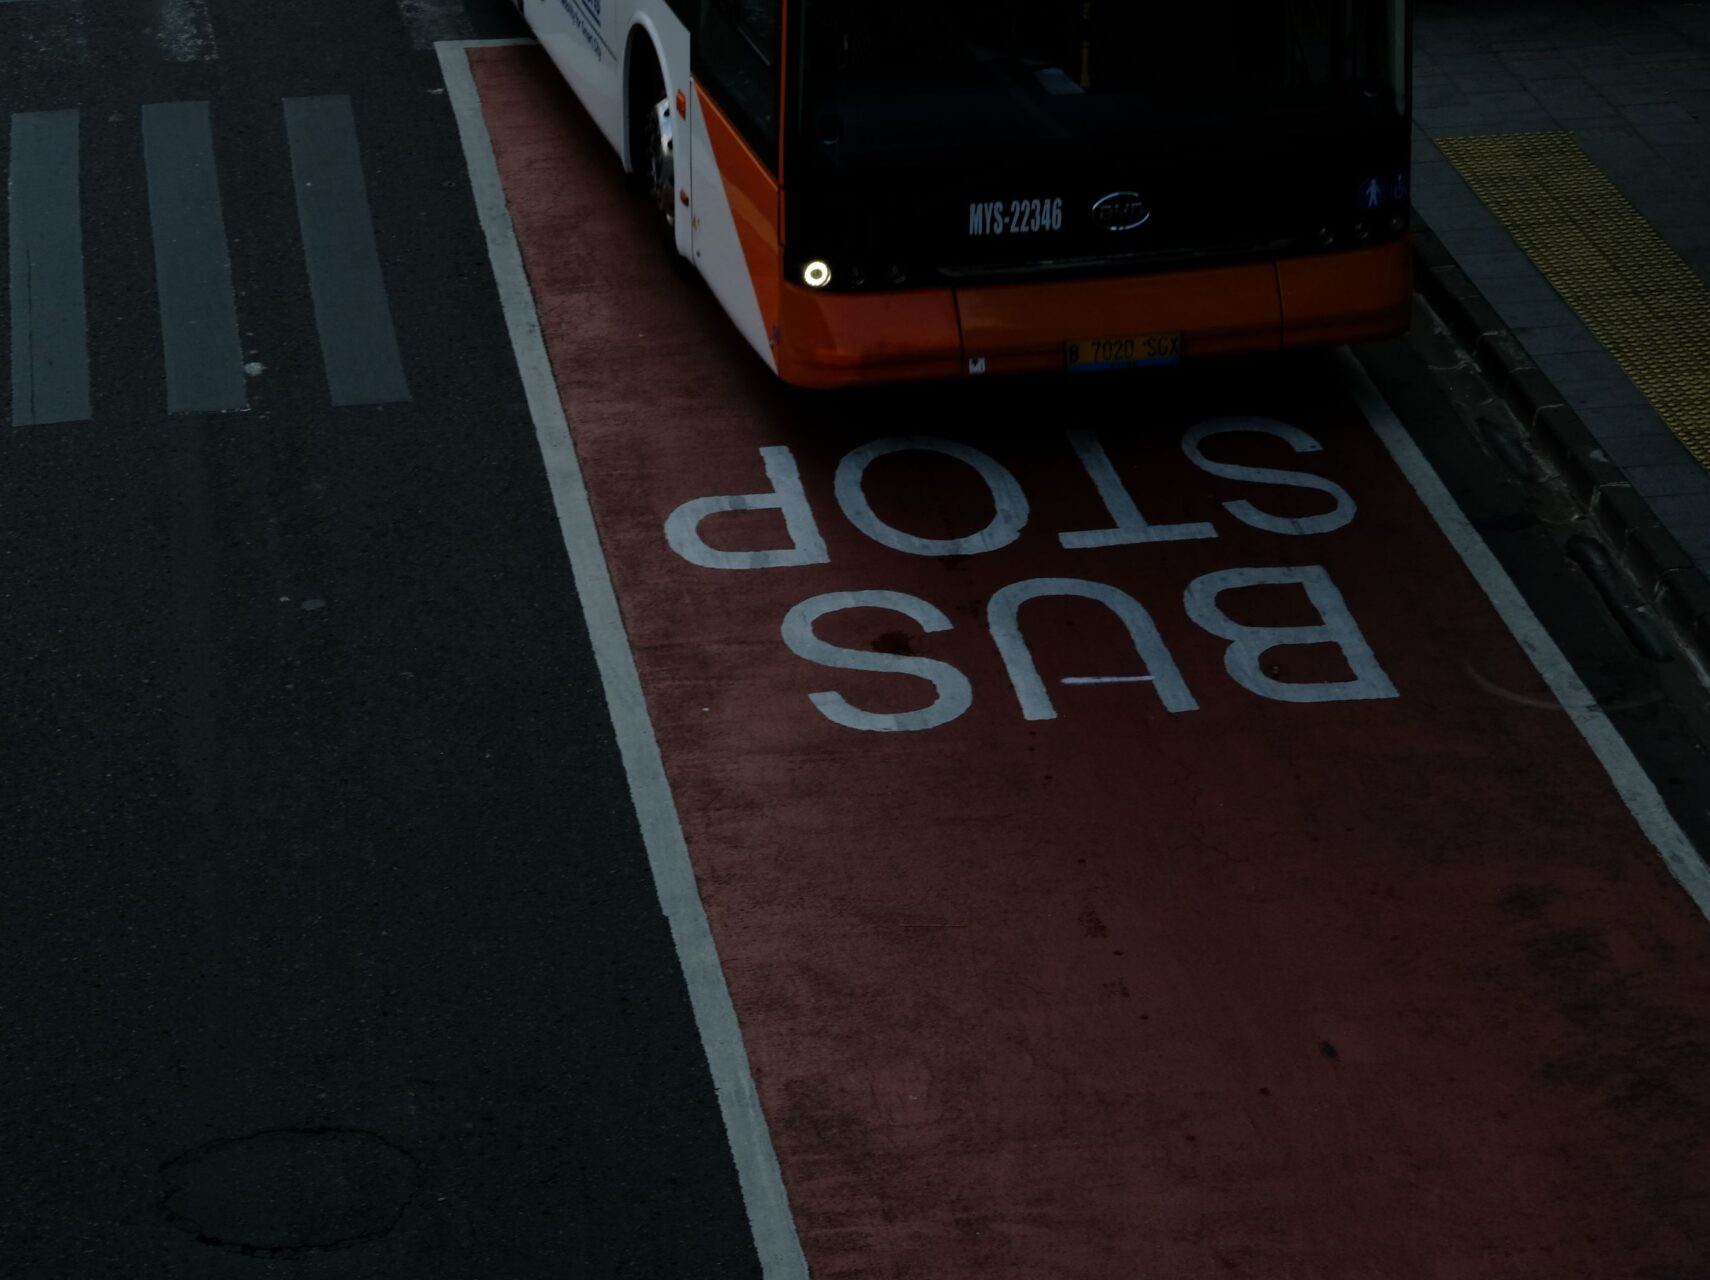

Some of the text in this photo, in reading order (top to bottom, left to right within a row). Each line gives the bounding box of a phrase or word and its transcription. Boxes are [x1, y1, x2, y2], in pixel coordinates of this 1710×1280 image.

[968, 196, 1064, 237] MYS-22346
[1068, 343, 1080, 364] B
[1090, 339, 1135, 362] 7020
[664, 416, 1358, 571] STOP
[781, 564, 1400, 733] BUS
